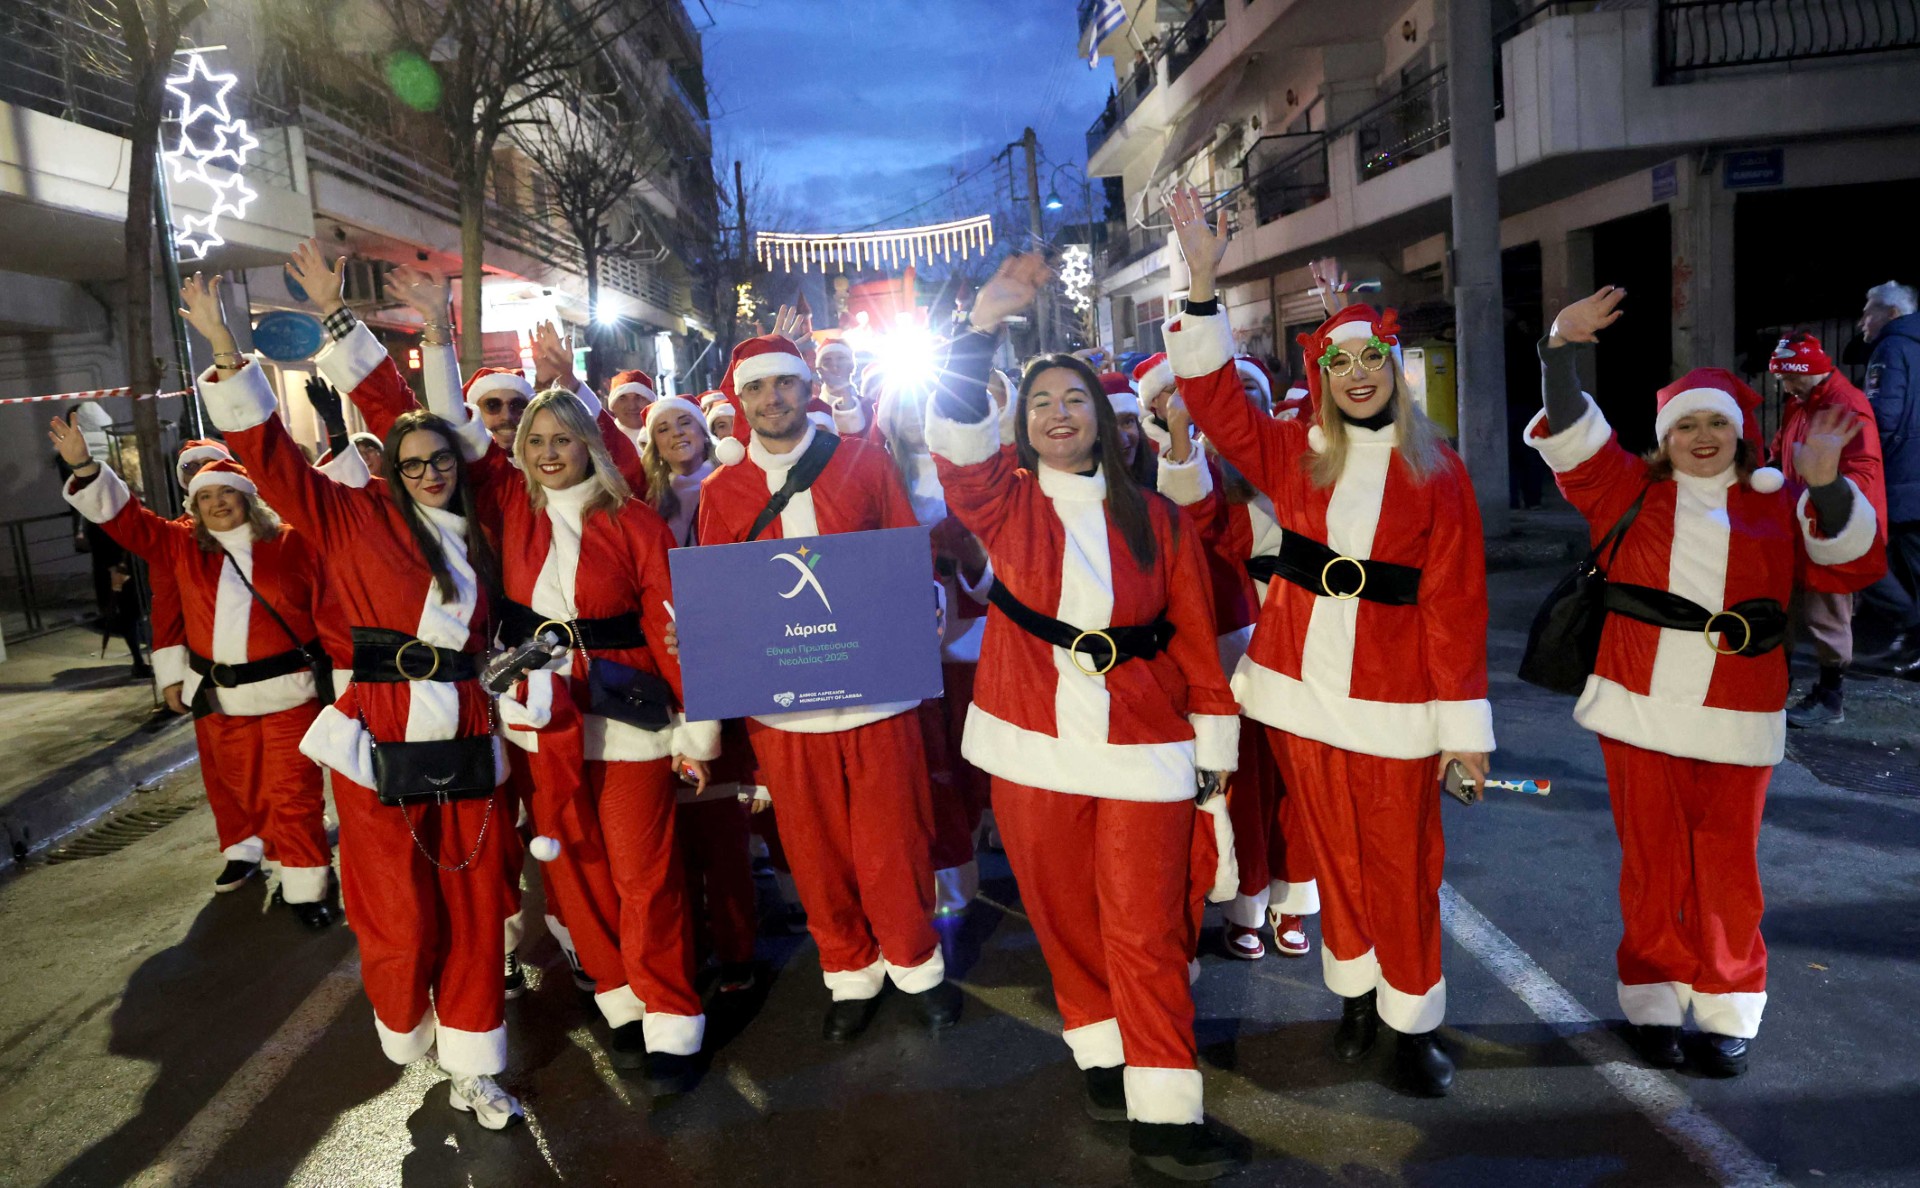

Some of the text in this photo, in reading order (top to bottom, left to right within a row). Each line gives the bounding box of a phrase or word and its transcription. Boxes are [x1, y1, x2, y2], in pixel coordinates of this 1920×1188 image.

[1781, 362, 1809, 372] XMAS
[785, 622, 837, 638] λάρισα
[766, 640, 859, 656] Εθνική Πρωτεύουσα
[779, 651, 849, 666] Νεολαίας 2025
